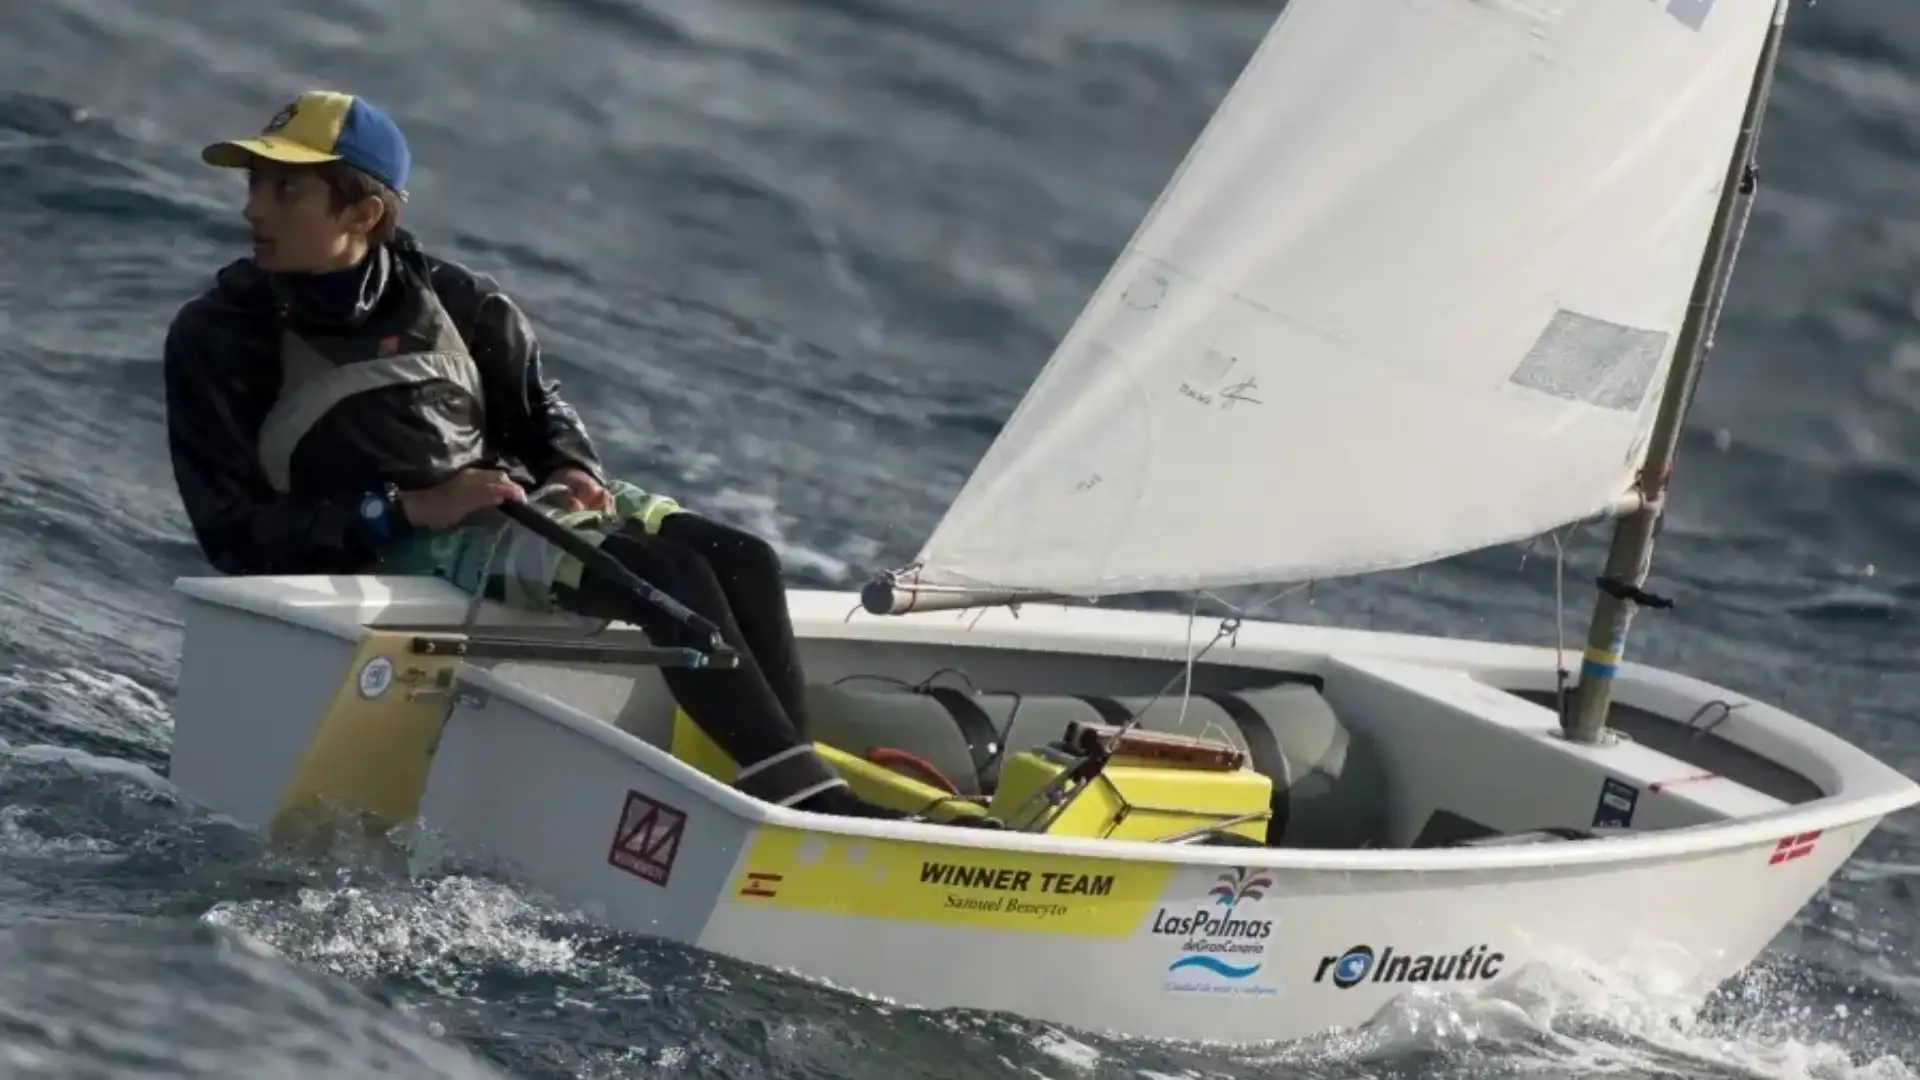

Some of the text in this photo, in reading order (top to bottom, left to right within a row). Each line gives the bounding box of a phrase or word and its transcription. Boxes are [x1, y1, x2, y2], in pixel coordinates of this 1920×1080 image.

[920, 861, 1115, 897] WINNER TEAM
[945, 893, 1068, 919] Samuel Beneyto
[1152, 907, 1273, 939] LasPalmas
